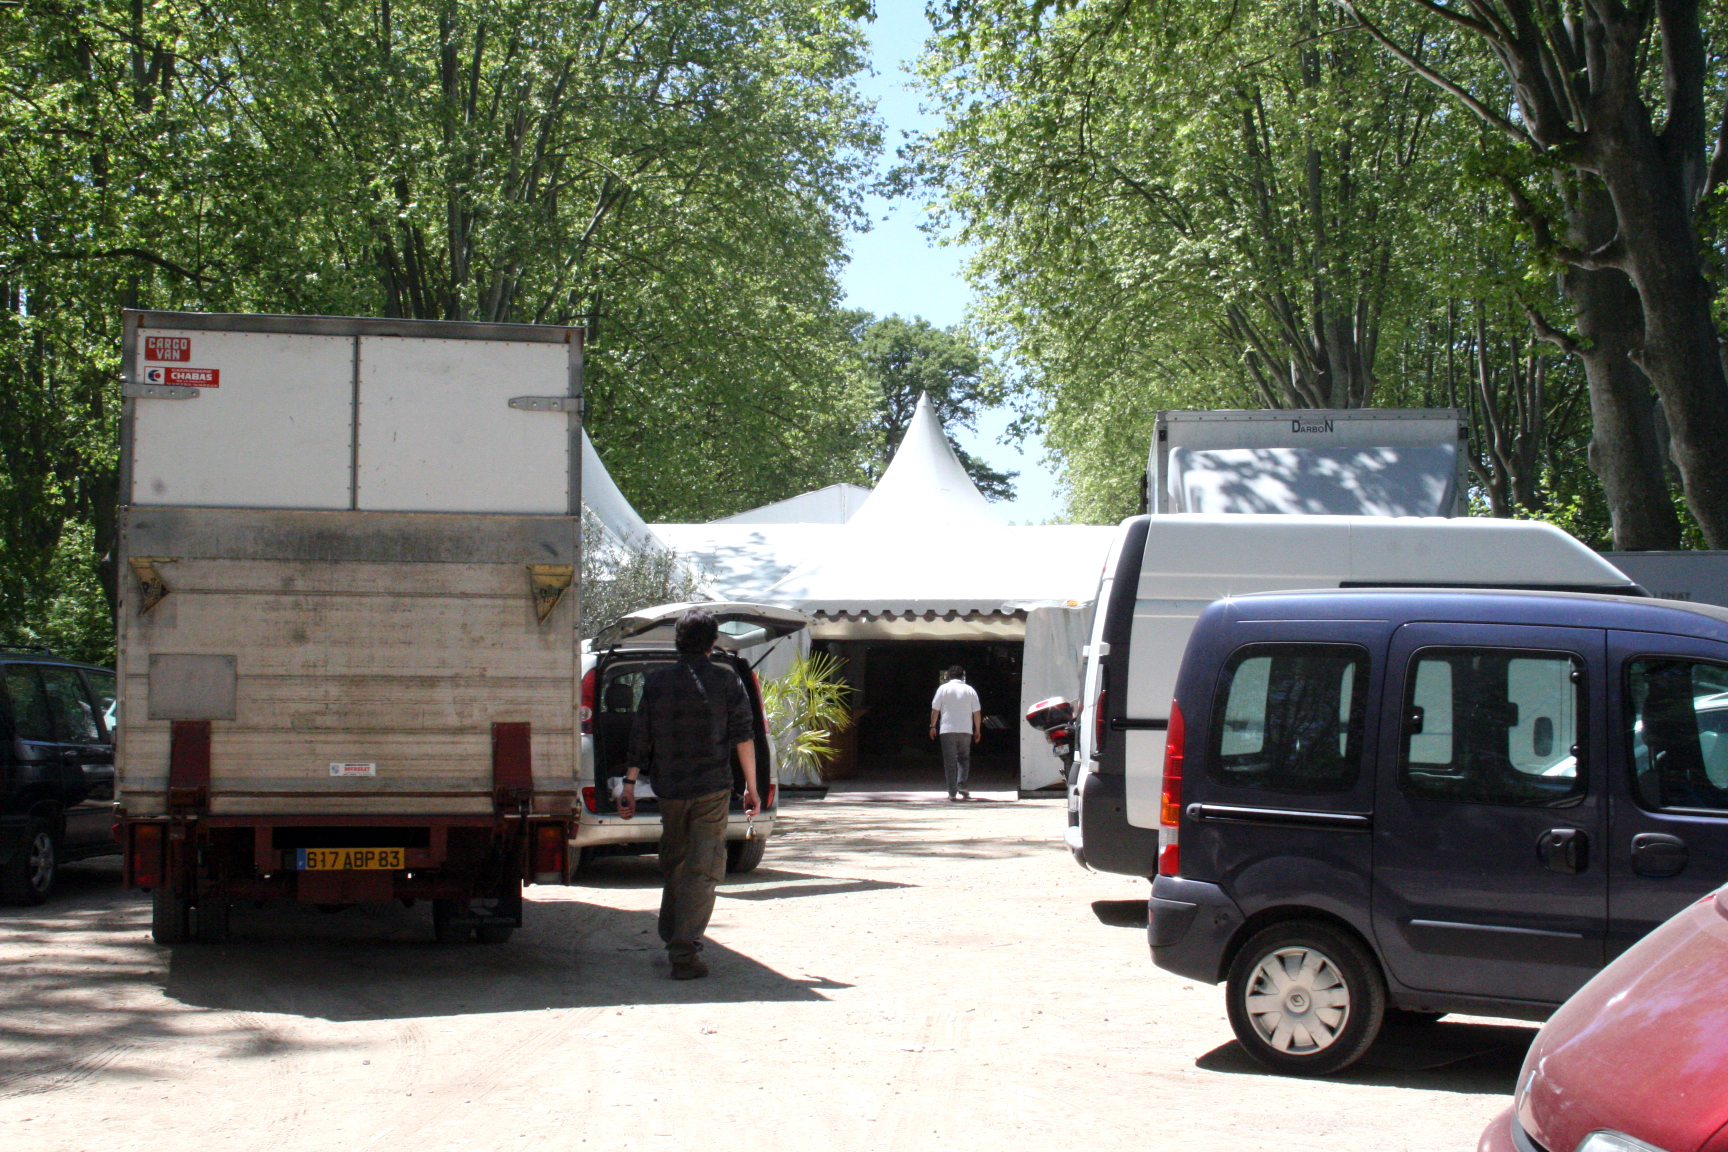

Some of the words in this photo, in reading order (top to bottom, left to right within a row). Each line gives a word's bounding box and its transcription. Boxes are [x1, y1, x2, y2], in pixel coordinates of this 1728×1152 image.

[148, 338, 188, 350] CARGO
[156, 348, 180, 360] VAN
[171, 372, 213, 381] CHABAS
[1292, 419, 1334, 433] DARBON
[306, 851, 339, 869] 617
[343, 851, 375, 869] ABP
[378, 851, 400, 868] 83
